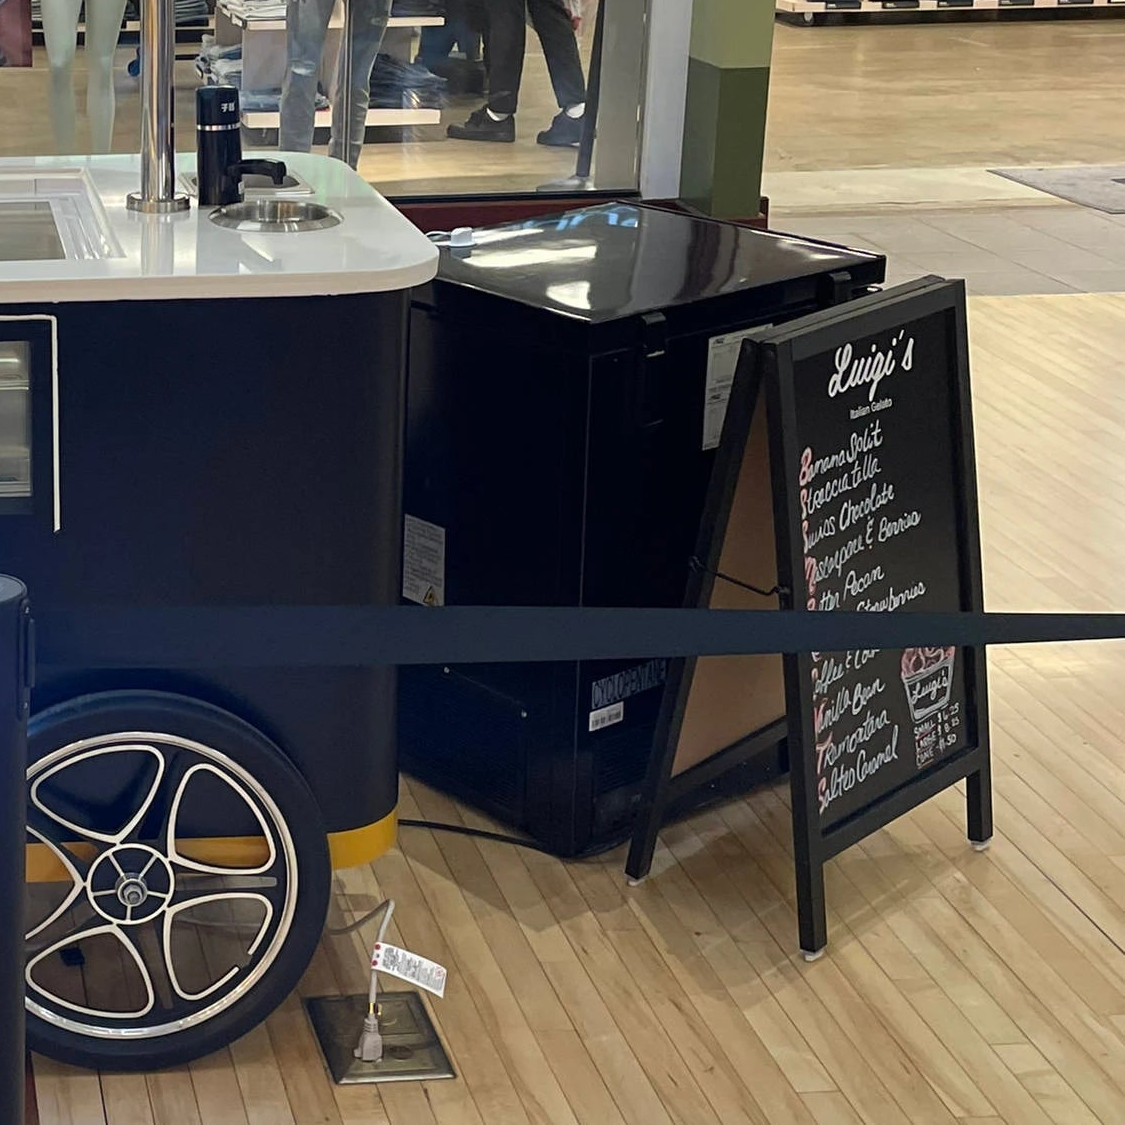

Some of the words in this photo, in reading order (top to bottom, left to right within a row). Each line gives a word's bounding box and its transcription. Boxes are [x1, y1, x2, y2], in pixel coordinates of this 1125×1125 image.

[828, 329, 914, 402] Luigi's
[850, 404, 871, 420] Italian
[871, 397, 893, 413] Gelato
[799, 446, 846, 486] Banana
[845, 419, 884, 463] Split
[839, 483, 895, 531] Chocolate
[843, 566, 885, 601] Pecan
[851, 678, 886, 716] Bean
